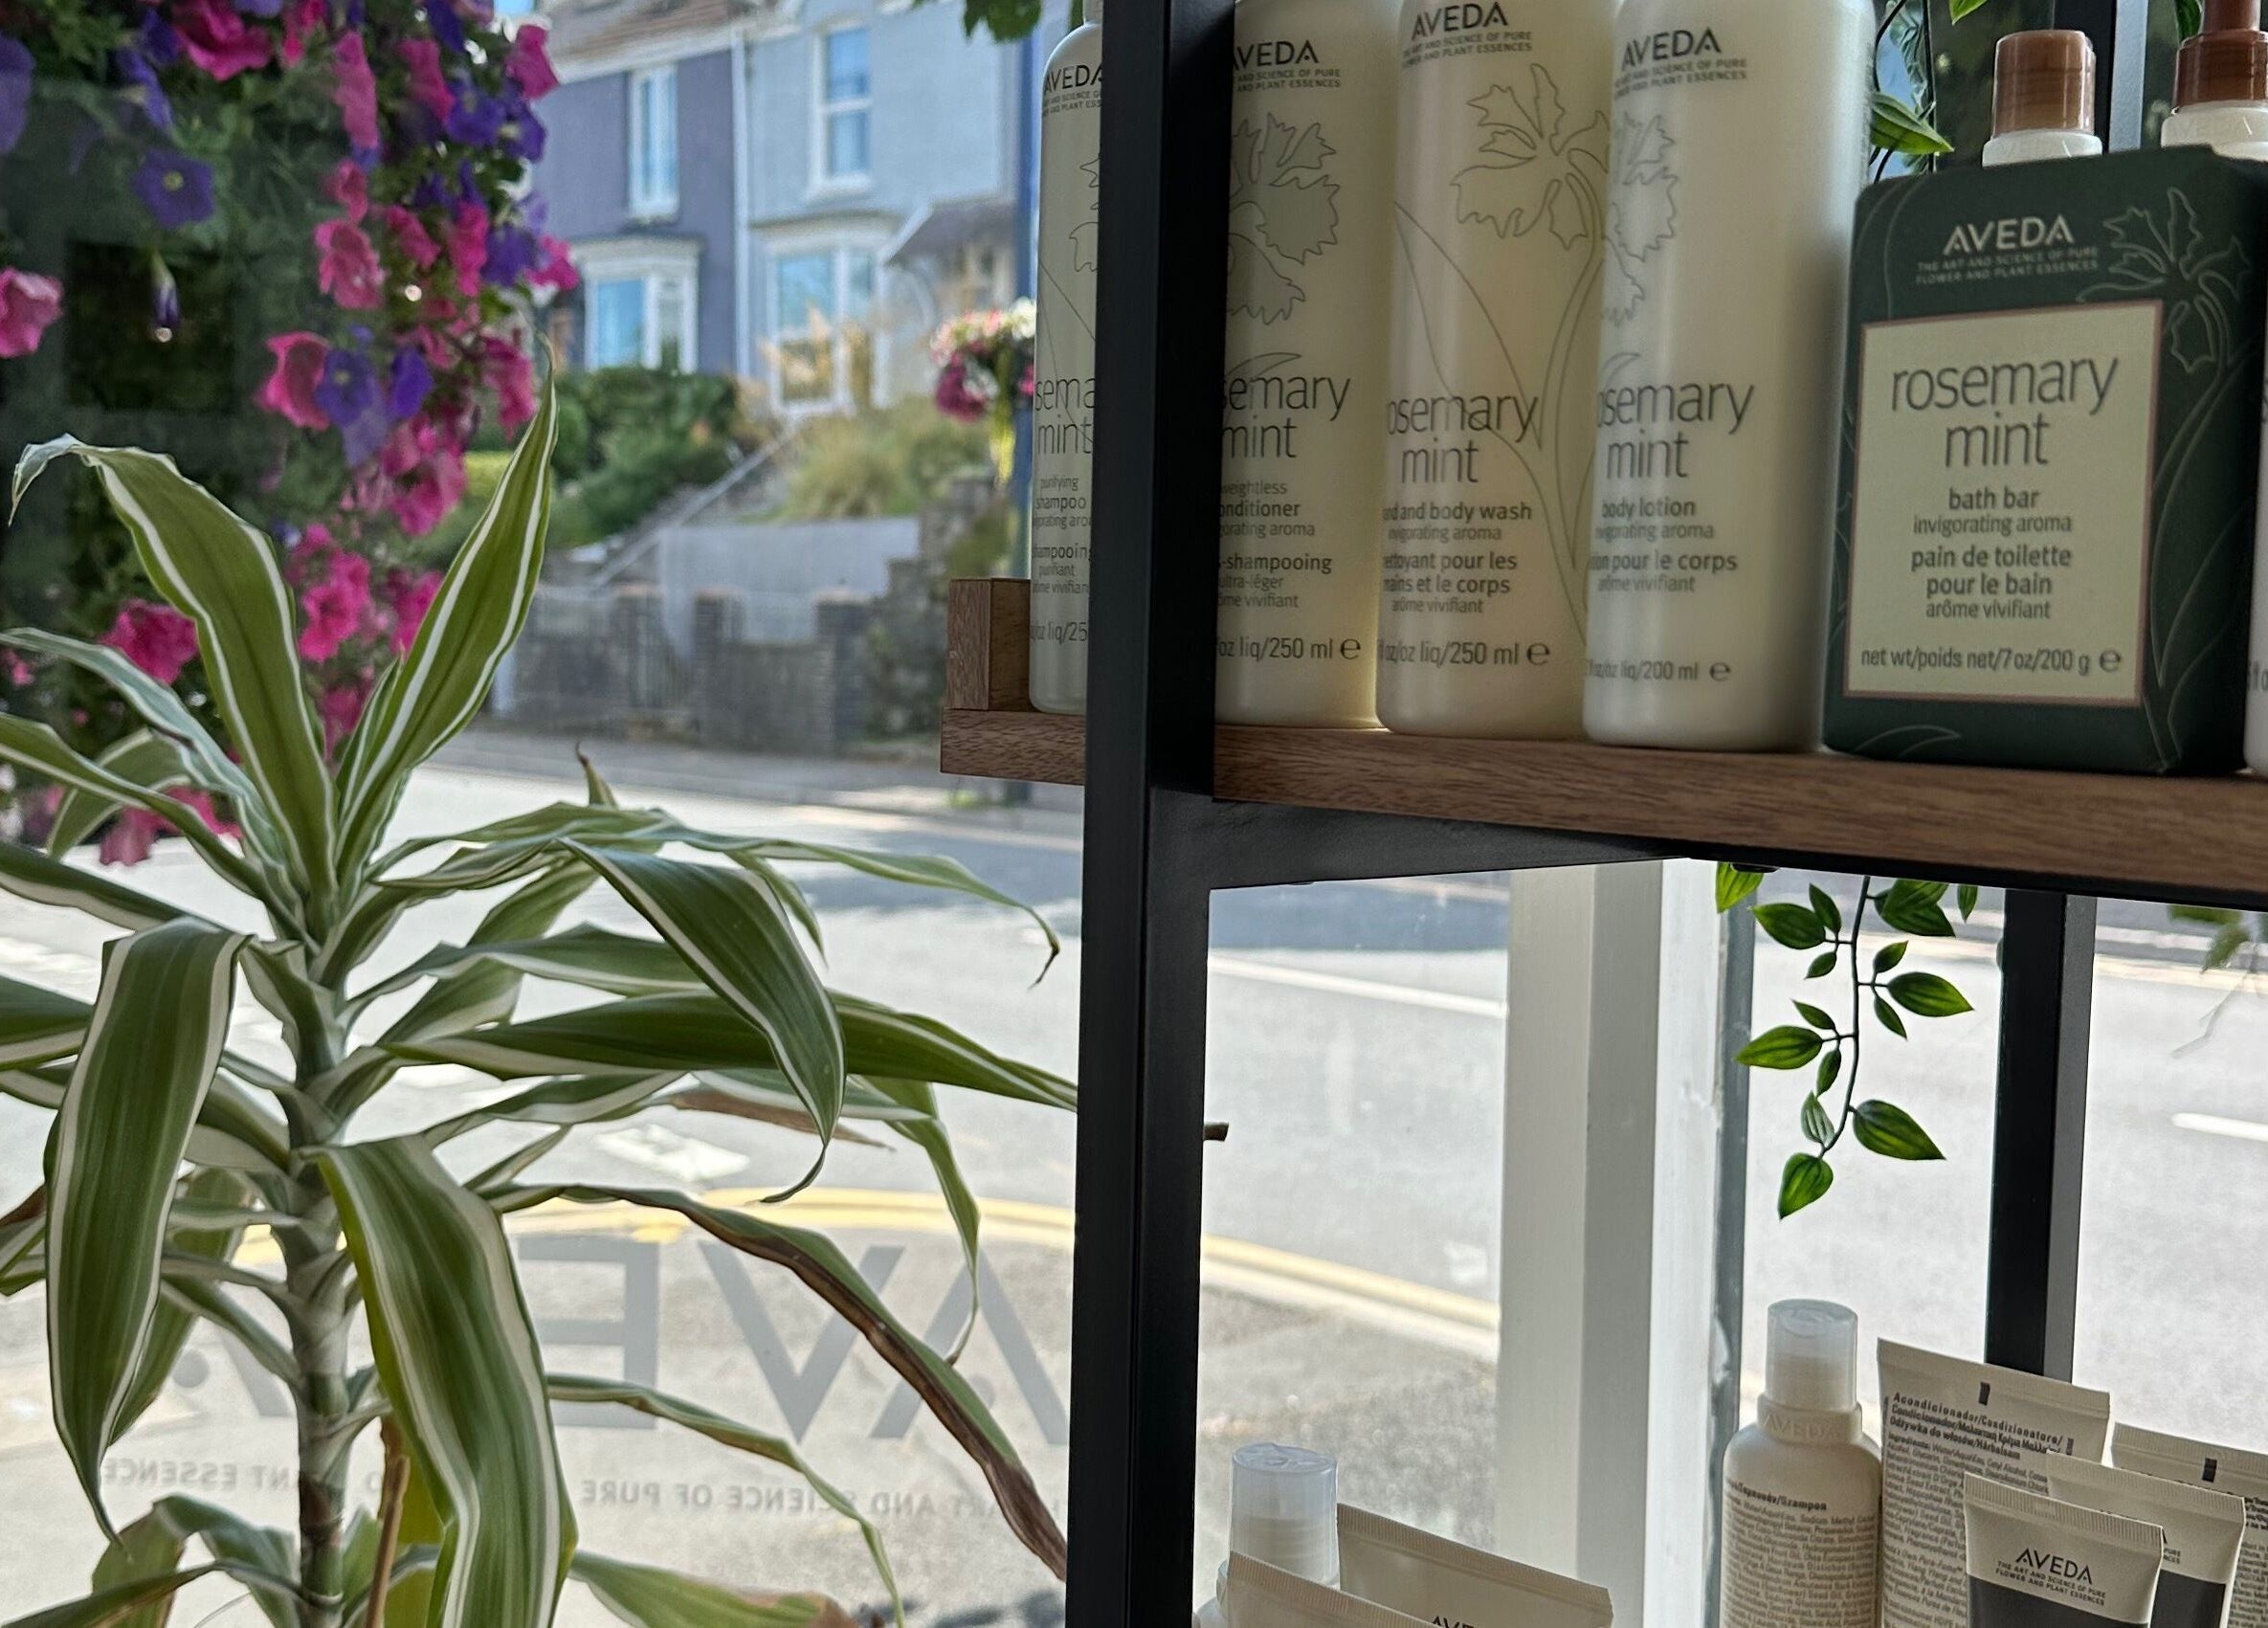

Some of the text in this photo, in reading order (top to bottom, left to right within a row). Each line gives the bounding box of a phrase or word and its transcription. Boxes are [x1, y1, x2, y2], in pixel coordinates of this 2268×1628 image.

[1412, 1, 1509, 40] AVEDA
[1621, 27, 1722, 72] AVEDA
[1288, 78, 1342, 89] ESSENCES
[1943, 212, 2075, 256] AVEDA
[1917, 260, 1939, 273] THE
[1968, 256, 1991, 268] AND
[1966, 268, 1990, 280] AND
[2035, 259, 2099, 276] ESSENCES
[1891, 357, 2119, 416] rosemary
[1386, 394, 1539, 443] osemary
[1596, 383, 1755, 435] osemary
[1036, 415, 1094, 455] mint
[1223, 416, 1298, 458] mint
[1945, 412, 2051, 467] mint
[1401, 437, 1480, 483] mint
[1607, 430, 1690, 479] mint
[1220, 499, 1301, 519] onditioner
[1601, 496, 1696, 521] body lotion
[1948, 484, 2041, 510] bath bar
[1429, 502, 1475, 524] body
[1479, 501, 1533, 521] wash
[1269, 524, 1316, 537] aroma
[1453, 526, 1502, 541] aroma
[1660, 524, 1716, 540] aroma
[1914, 514, 2073, 539] invigorating aroma
[1219, 552, 1333, 575] -shampooing
[1440, 553, 1485, 574] pour
[1488, 550, 1519, 570] les
[1612, 554, 1649, 574] pour
[1654, 548, 1673, 571] le
[1677, 553, 1739, 576] corps
[1911, 543, 2074, 573] pain de toilette
[1415, 575, 1433, 593] et
[1434, 573, 1453, 593] le
[1456, 577, 1512, 598] corps
[1926, 571, 2054, 600] pour le bain
[1925, 598, 2052, 619] arôme vivifiant
[1309, 636, 1334, 660] ml
[1493, 641, 1520, 665] ml
[1860, 649, 1887, 667] net
[1890, 645, 1962, 672] wt/poids
[2079, 653, 2090, 676] g
[1677, 661, 1700, 680] ml
[1929, 1426, 1942, 1438] do
[1997, 1560, 2012, 1571] THE
[2013, 1565, 2029, 1575] ART
[2030, 1571, 2046, 1580] AND
[2014, 1547, 2093, 1585] AVEDA
[1995, 1567, 2105, 1606] FLOWER AND PLANT ESSENCES
